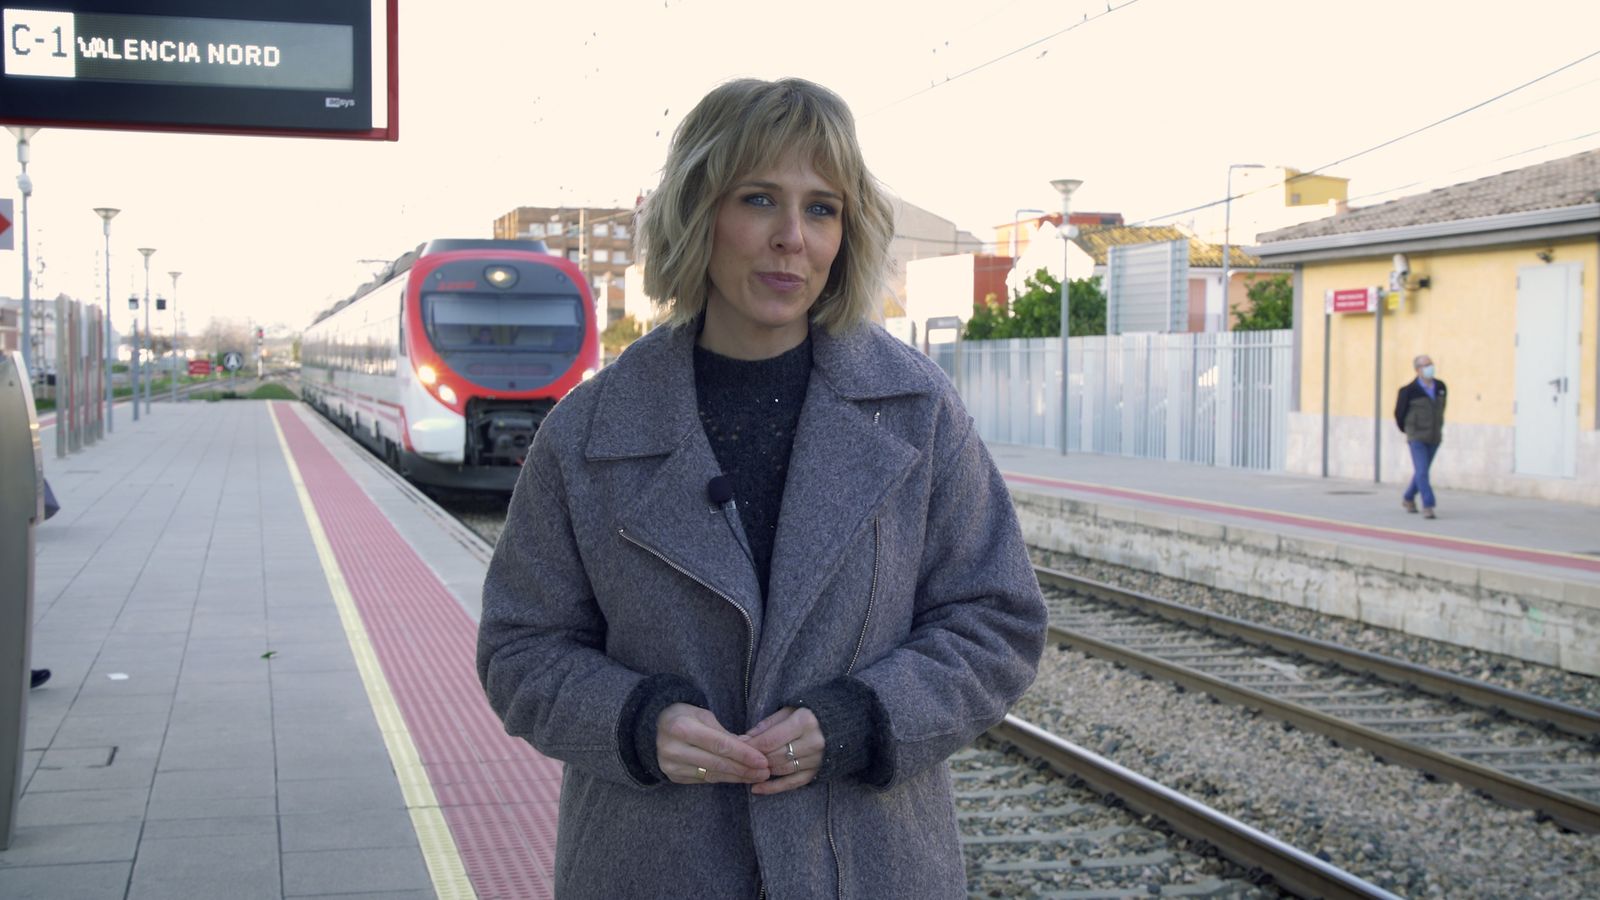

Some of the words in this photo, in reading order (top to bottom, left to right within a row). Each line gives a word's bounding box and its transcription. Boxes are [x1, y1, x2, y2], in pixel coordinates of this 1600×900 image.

[12, 24, 67, 57] C-1
[77, 36, 200, 63] VALENCIA
[208, 43, 280, 66] NORD
